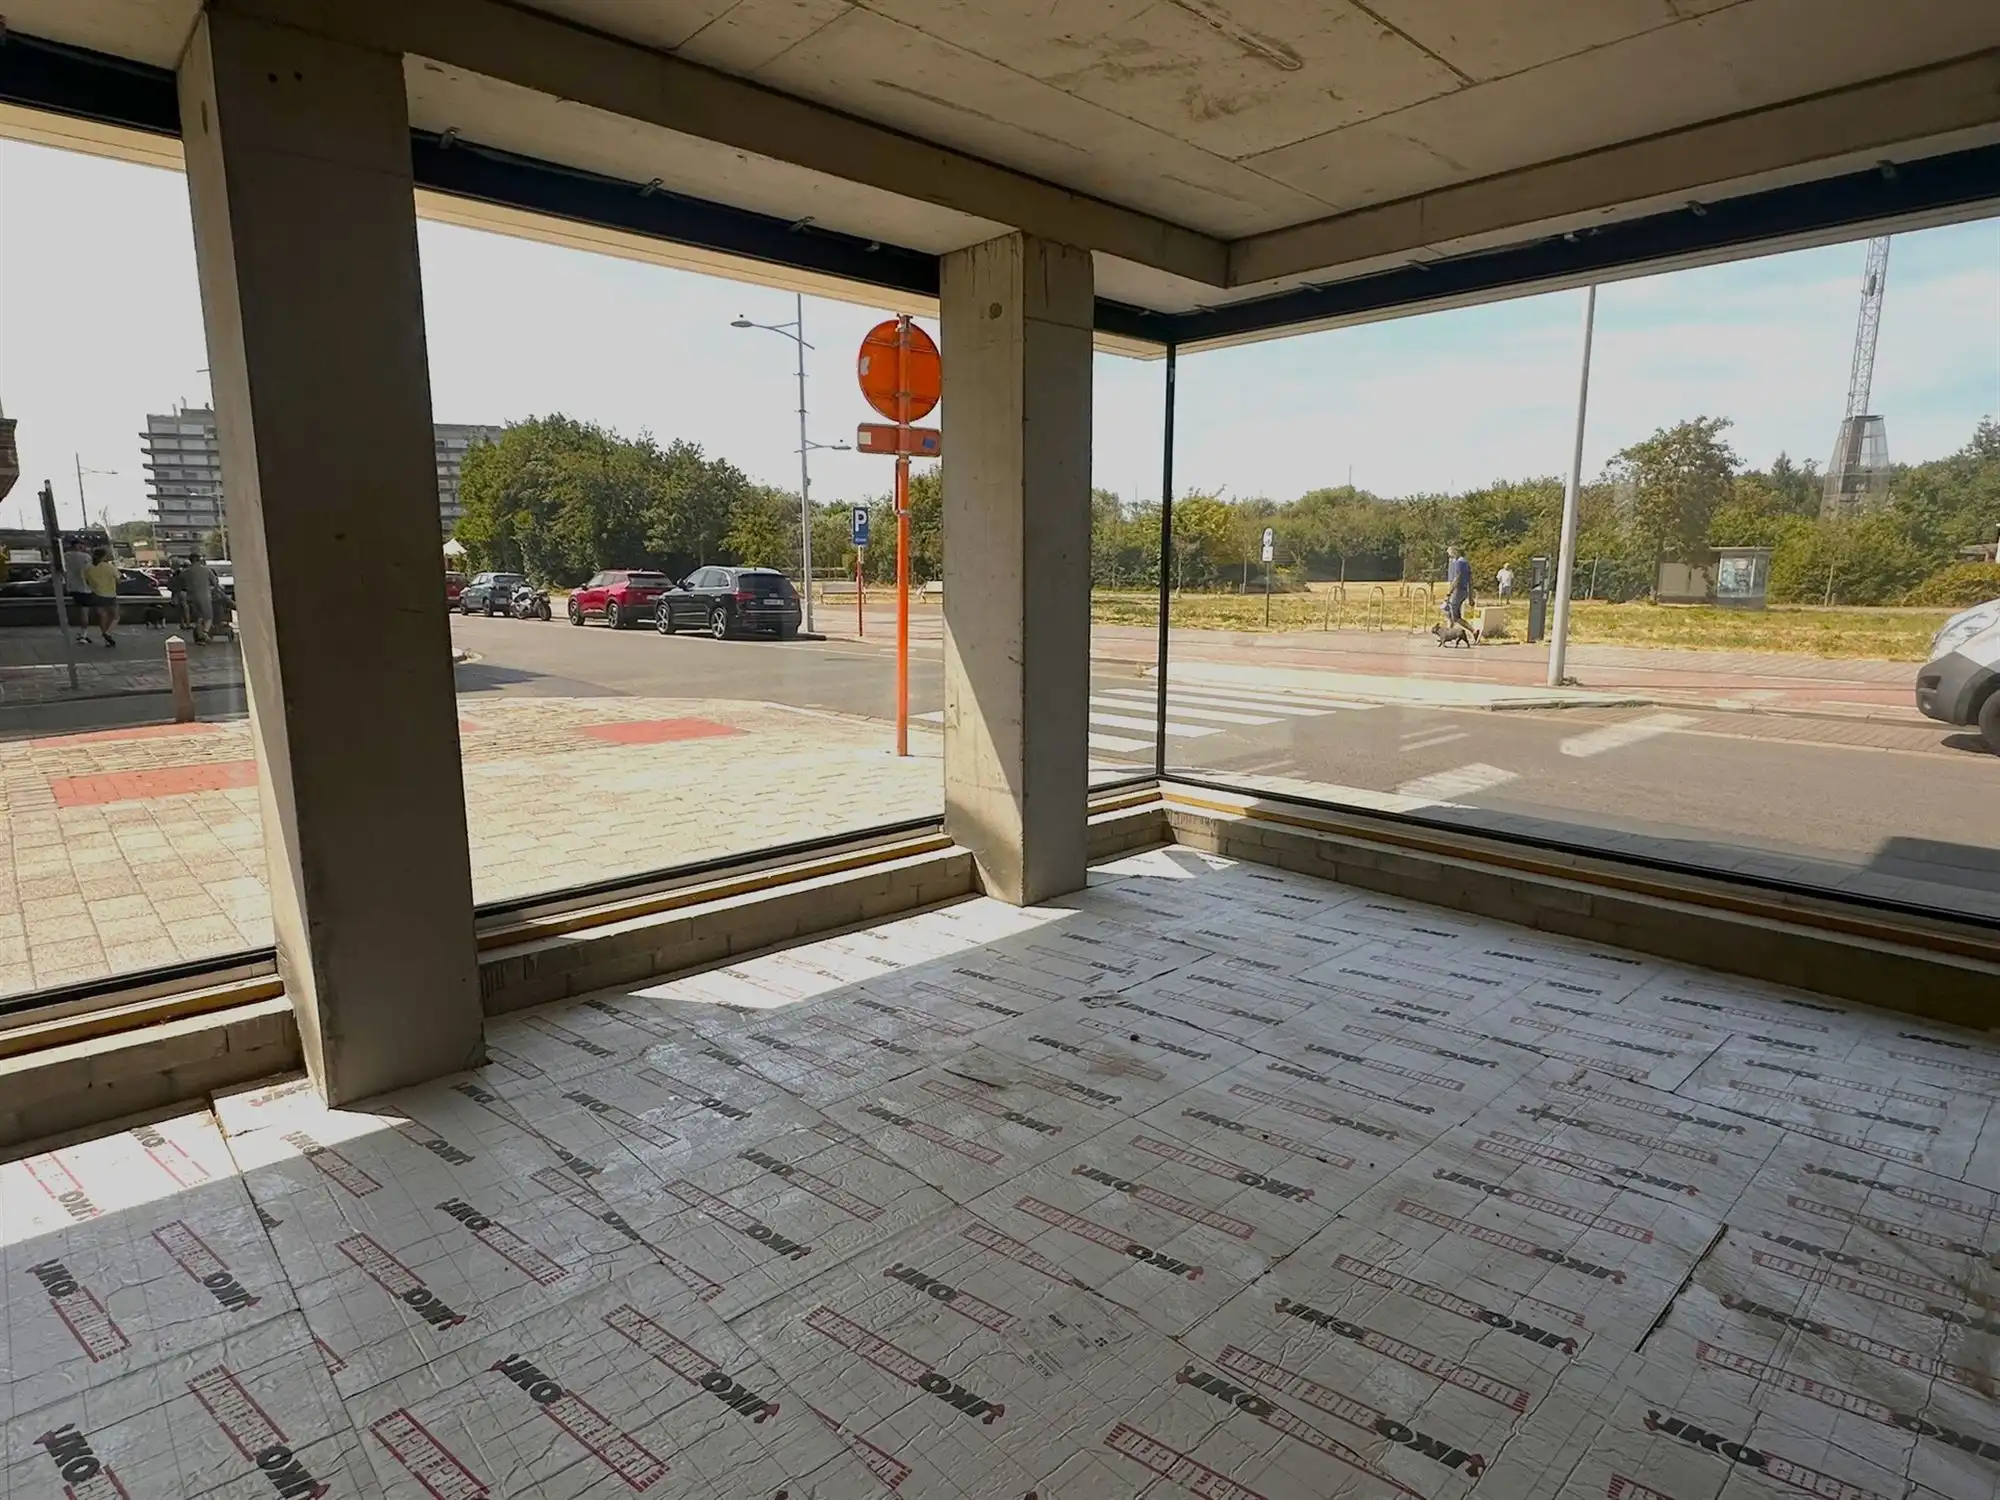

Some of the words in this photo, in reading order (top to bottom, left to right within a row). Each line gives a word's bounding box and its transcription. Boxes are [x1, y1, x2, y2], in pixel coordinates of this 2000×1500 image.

[855, 510, 867, 532] P
[1076, 1165, 1141, 1194] IKO
[1237, 1172, 1309, 1199] IKO
[1439, 1170, 1513, 1199] IKO
[441, 1199, 494, 1231] IKO
[1126, 1242, 1202, 1277] IKO
[1535, 1245, 1622, 1282] IKO
[31, 1262, 81, 1298] IKO
[200, 1270, 258, 1308] IKO
[888, 1265, 961, 1303] IKO
[401, 1286, 466, 1326] IKO
[1279, 1300, 1366, 1342] IKO
[1477, 1306, 1573, 1350] IKO
[497, 1356, 568, 1407] IKO
[698, 1368, 777, 1419] IKO
[916, 1369, 1002, 1420] IKO
[1183, 1367, 1277, 1418] IKO
[43, 1426, 106, 1485] IKO
[1375, 1414, 1482, 1472] IKO
[1653, 1412, 1771, 1472] IKO
[256, 1441, 331, 1500] IKO
